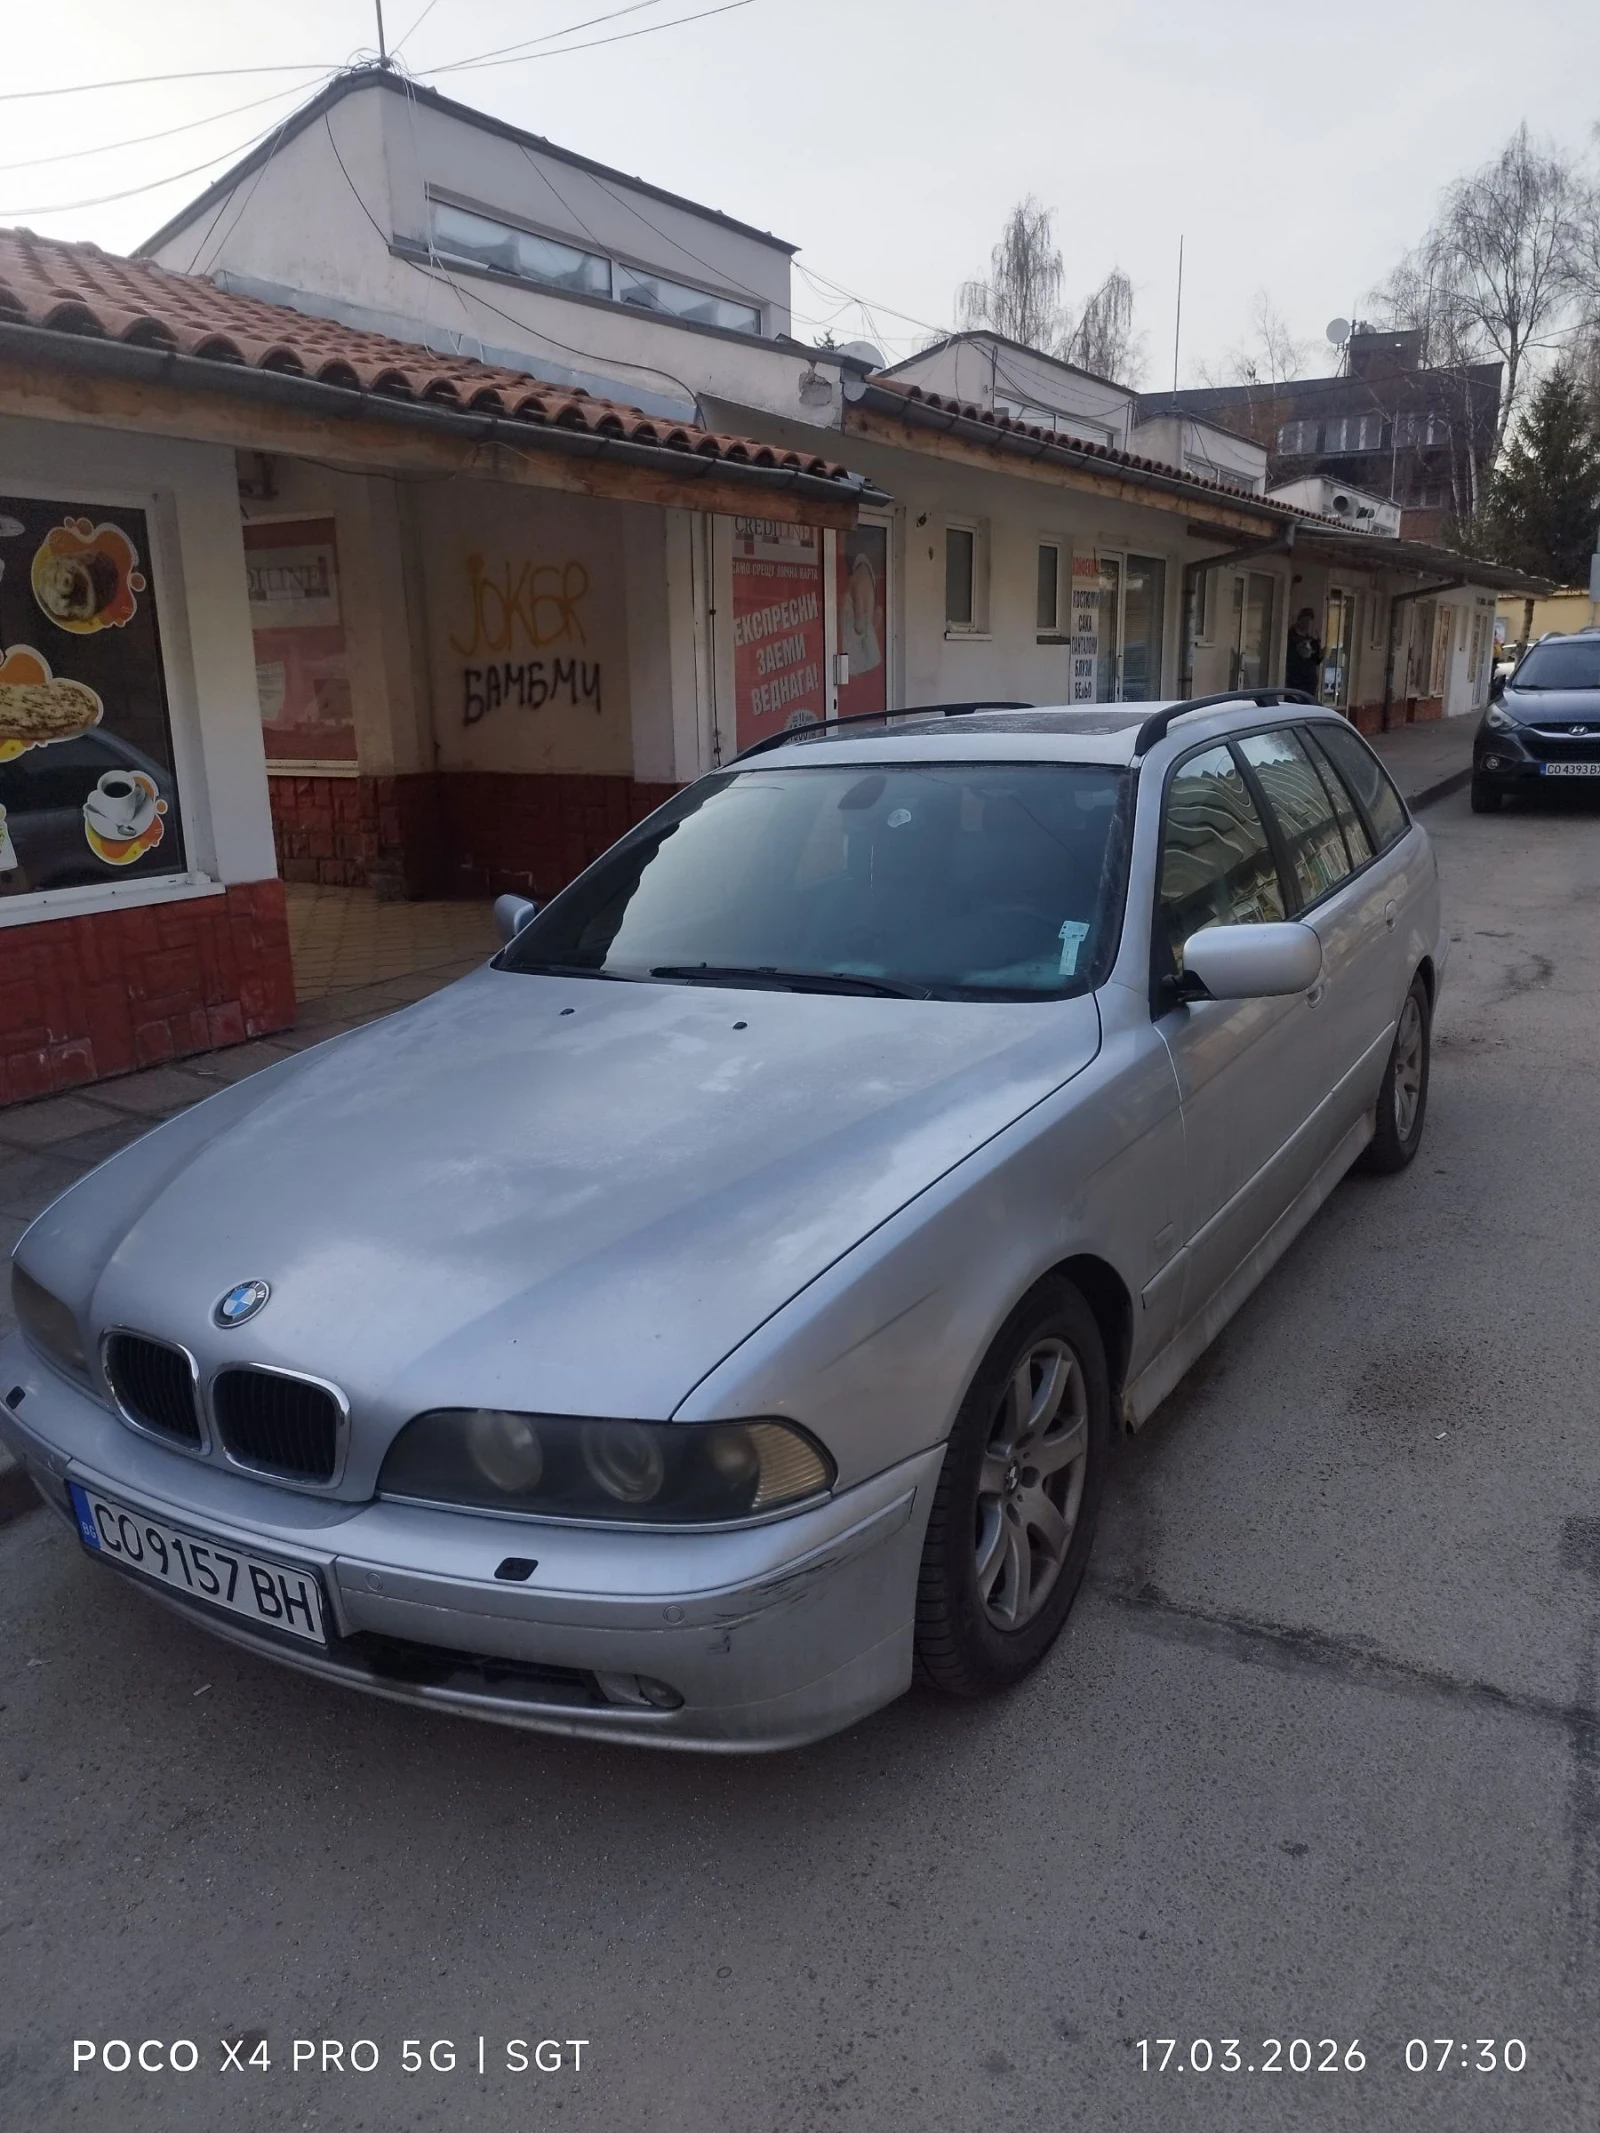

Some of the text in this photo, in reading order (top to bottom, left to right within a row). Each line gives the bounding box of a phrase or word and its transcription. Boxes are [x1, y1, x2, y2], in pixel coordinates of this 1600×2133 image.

[752, 563, 775, 578] СРЕЩУ
[799, 567, 818, 581] КАРТА
[449, 553, 589, 657] JOKER
[734, 591, 819, 647] ЕКСПРЕСНИ
[1078, 614, 1093, 633] САКА
[756, 632, 807, 676] ЗАЕМИ
[1075, 659, 1093, 677] БЛУЗИ
[751, 662, 819, 717] ВЕДНАГА!
[81, 1521, 97, 1539] BG
